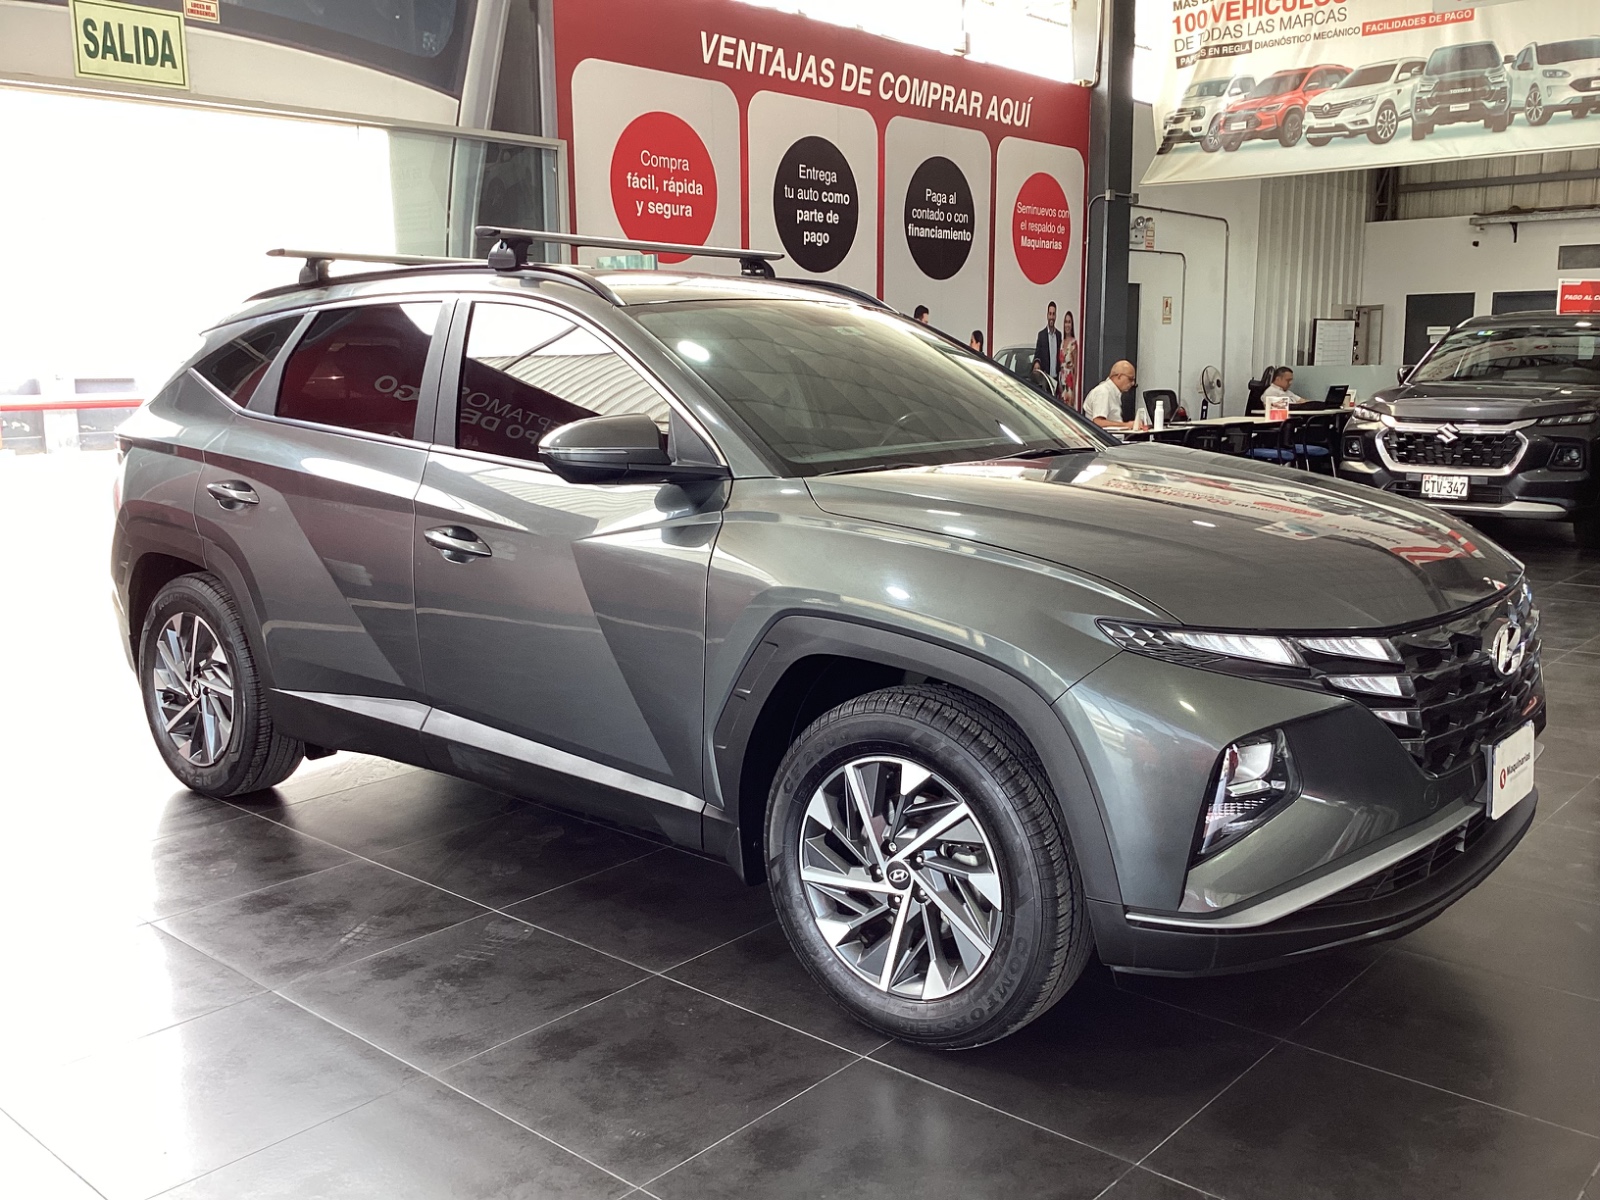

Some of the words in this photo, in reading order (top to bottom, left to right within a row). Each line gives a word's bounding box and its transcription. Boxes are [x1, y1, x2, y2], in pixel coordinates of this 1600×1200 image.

[1172, 10, 1208, 34] 100
[1174, 36, 1194, 52] DE
[1247, 17, 1275, 36] LAS
[1279, 7, 1348, 31] MARCAS
[1365, 16, 1427, 32] FACILIDADES
[1428, 14, 1442, 24] DE
[1444, 9, 1472, 21] PAGO
[83, 18, 177, 69] SALIDA
[1254, 33, 1312, 49] DIAGNÓSTICO
[1313, 26, 1360, 41] MECÁNICO
[1208, 47, 1220, 56] EN
[1222, 43, 1250, 54] REGLA
[701, 31, 835, 88] VENTAJAS
[841, 62, 874, 96] DE
[879, 71, 983, 118] COMPRAR
[986, 96, 1034, 128] AQUÍ
[640, 150, 689, 173] Compra
[626, 172, 659, 194] fácil,
[663, 177, 704, 197] rápida
[799, 164, 837, 186] Entrega
[784, 184, 794, 199] tu
[797, 187, 819, 201] auto
[821, 191, 850, 205] como
[925, 188, 947, 206] Paga
[949, 191, 957, 205] al
[636, 200, 644, 217] y
[648, 201, 693, 219] segura
[797, 208, 824, 224] parte
[826, 209, 839, 224] de
[911, 207, 945, 222] contado
[946, 212, 952, 222] o
[954, 212, 969, 223] con
[1016, 201, 1057, 217] Seminuevos
[1057, 209, 1070, 218] con
[908, 223, 972, 242] financiamiento
[1020, 220, 1027, 230] el
[1028, 221, 1056, 234] respaldo
[1056, 223, 1065, 234] de
[803, 231, 830, 247] pago
[1021, 235, 1063, 250] Maquinarias
[1424, 479, 1467, 495] CTV-347
